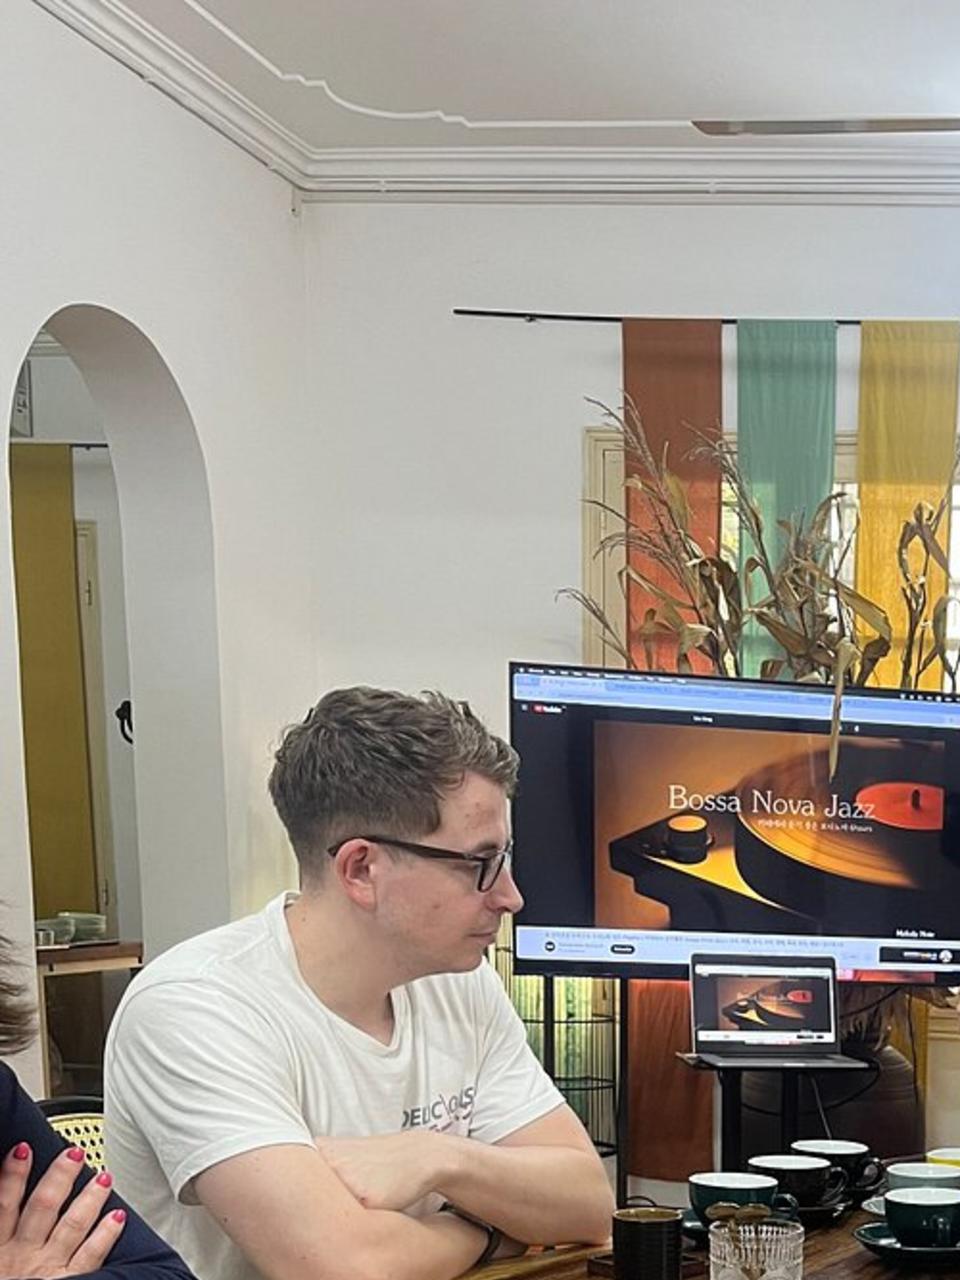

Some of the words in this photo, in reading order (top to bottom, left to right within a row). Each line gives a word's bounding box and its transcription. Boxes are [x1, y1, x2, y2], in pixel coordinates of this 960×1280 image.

[668, 784, 741, 813] Bossa
[752, 789, 814, 817] Nova
[824, 794, 876, 819] Jazz
